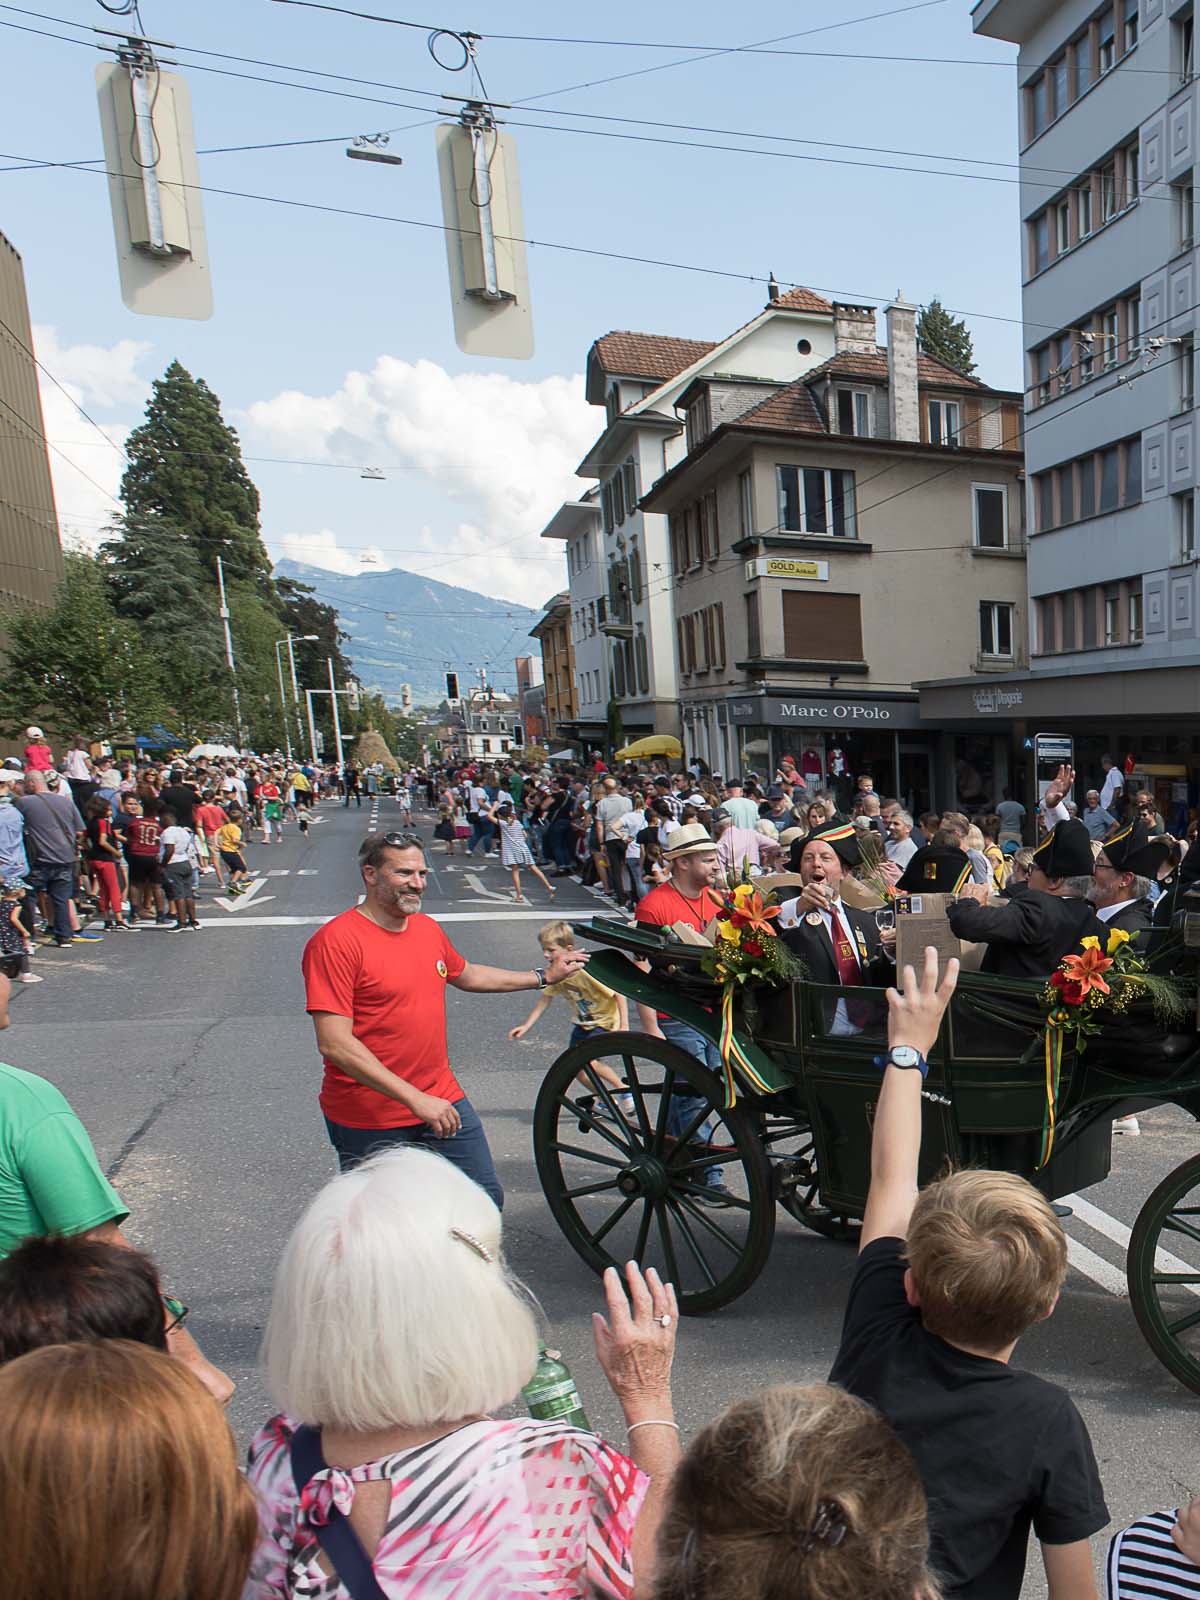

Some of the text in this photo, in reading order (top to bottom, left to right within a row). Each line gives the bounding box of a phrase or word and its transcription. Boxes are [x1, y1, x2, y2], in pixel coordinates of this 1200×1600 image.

[770, 562, 795, 571] GOLD
[780, 703, 890, 720] Marc O'Polo
[139, 825, 158, 846] 10
